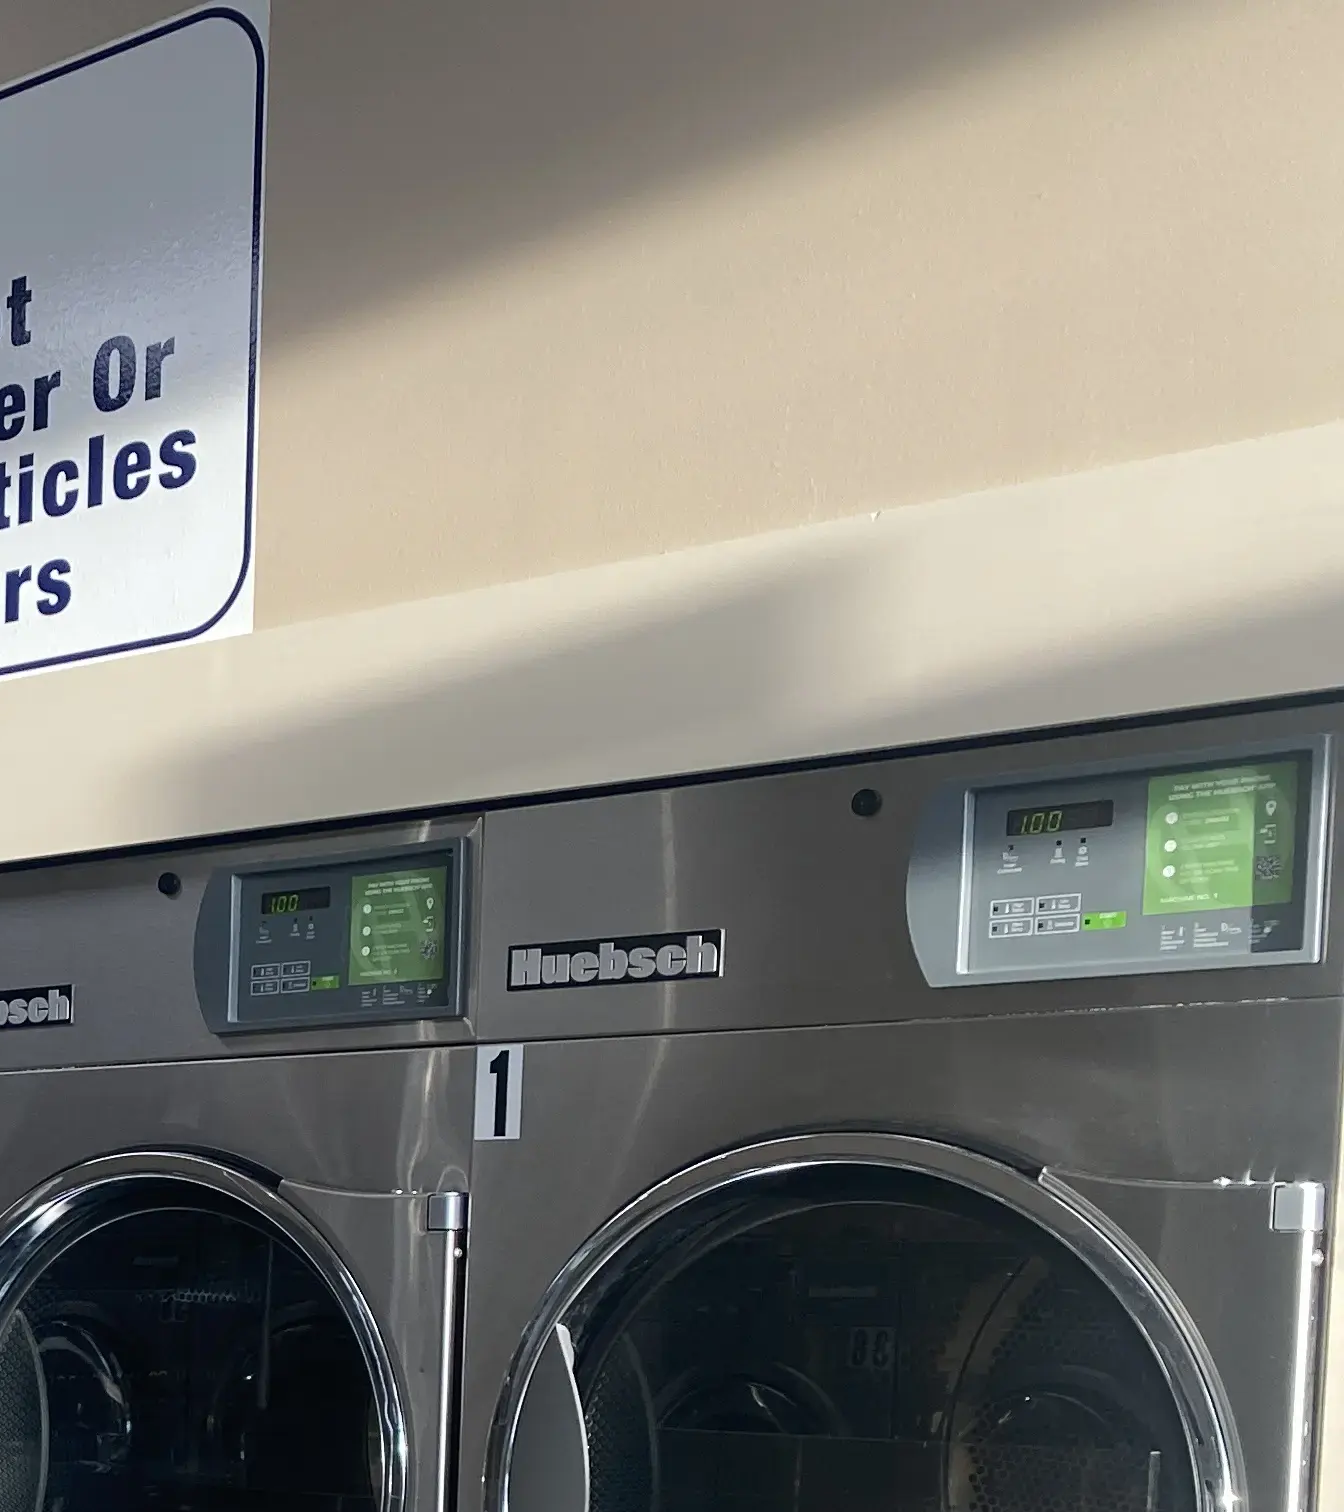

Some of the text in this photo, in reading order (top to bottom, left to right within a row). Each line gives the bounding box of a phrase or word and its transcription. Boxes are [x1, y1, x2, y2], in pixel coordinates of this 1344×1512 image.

[93, 334, 176, 412] Or
[511, 935, 717, 987] Huebsch
[490, 1050, 510, 1137] 1
